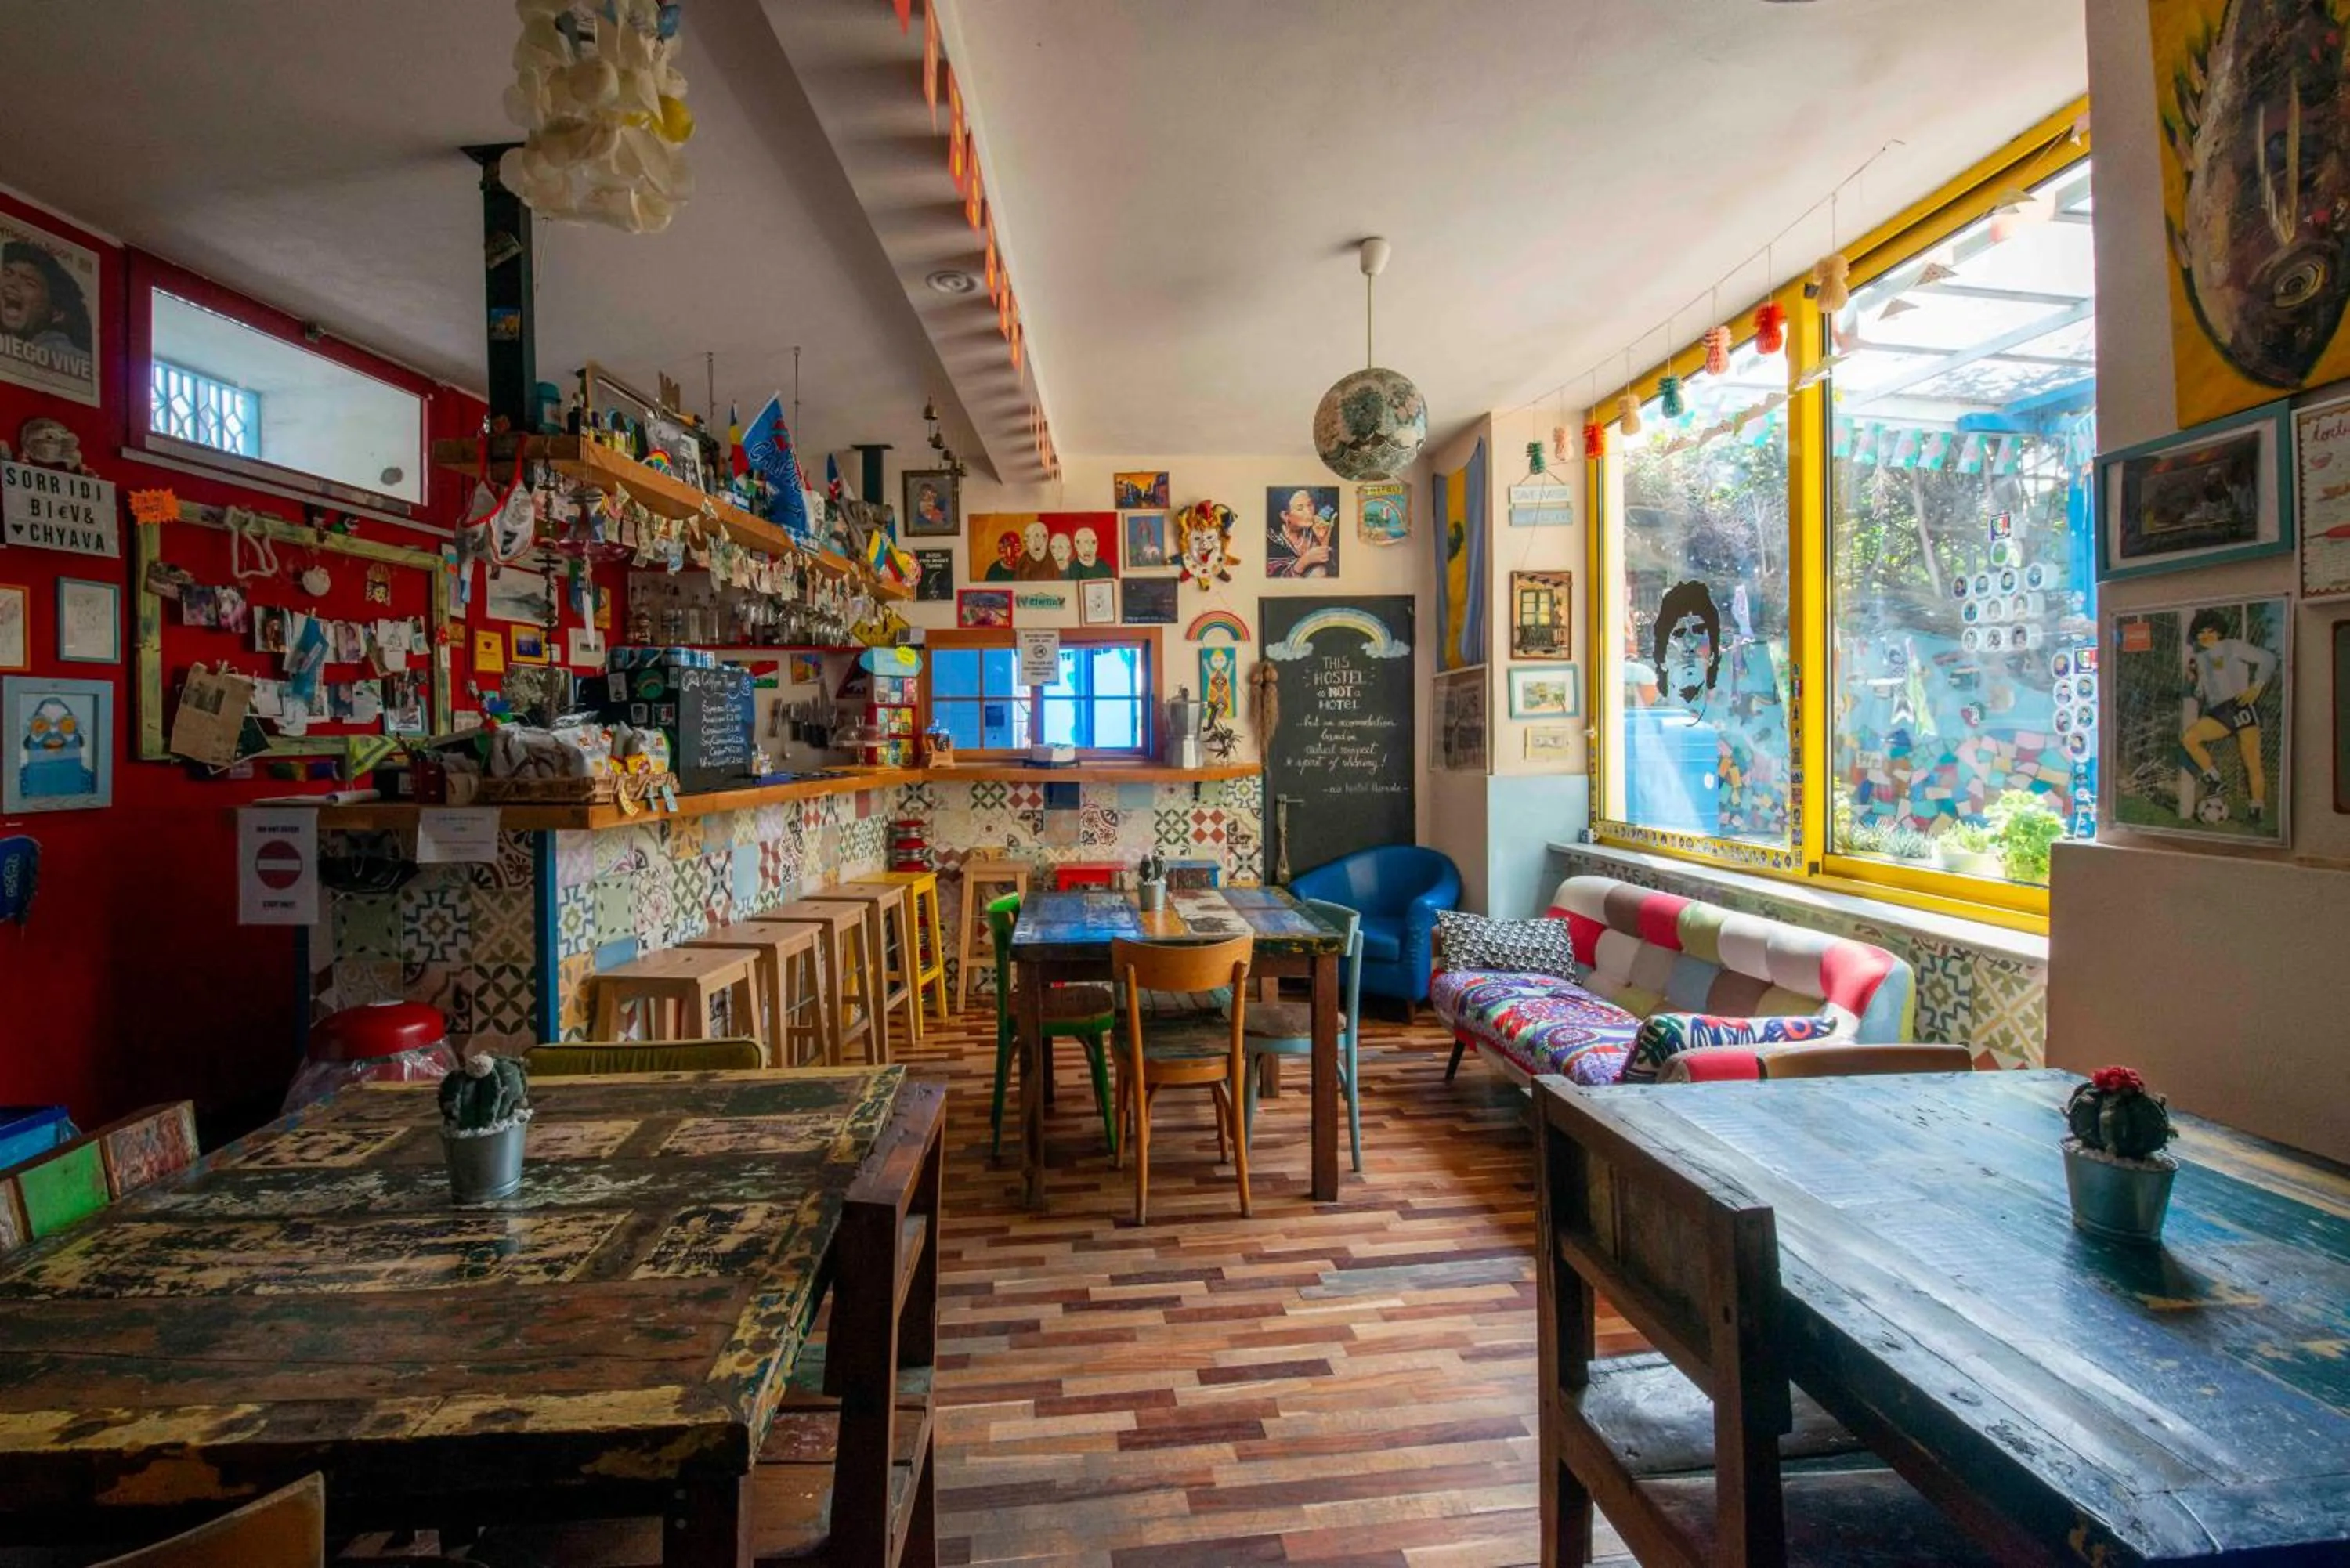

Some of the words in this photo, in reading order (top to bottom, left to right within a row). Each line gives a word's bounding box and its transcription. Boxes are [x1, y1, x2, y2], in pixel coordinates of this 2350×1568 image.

[51, 352, 92, 379] VIVE
[6, 468, 102, 502] SORRIDI
[30, 523, 105, 552] CHYAVA
[1322, 656, 1350, 670] THIS
[1314, 670, 1366, 685] HOSTEL
[1328, 686, 1354, 698] NOT
[2232, 709, 2252, 728] 10
